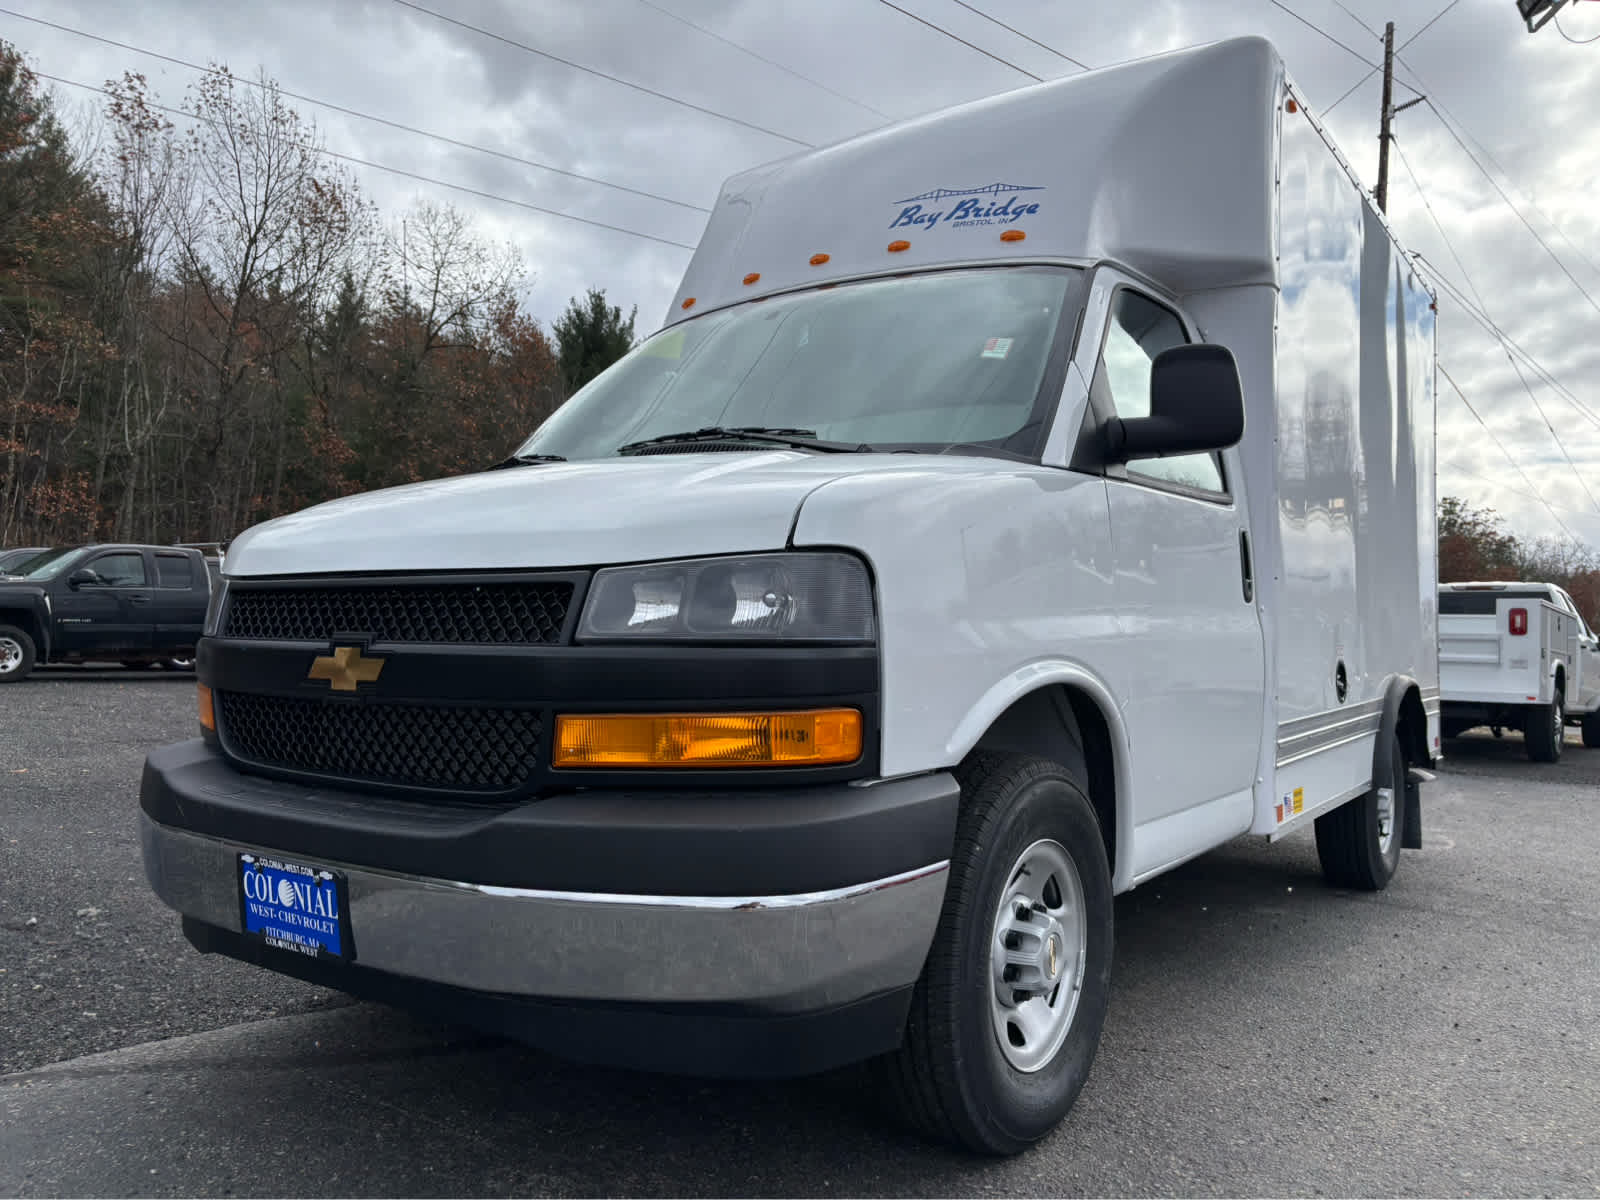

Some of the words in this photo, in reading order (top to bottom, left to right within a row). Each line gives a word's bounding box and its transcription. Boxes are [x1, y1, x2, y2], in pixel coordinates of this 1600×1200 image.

[888, 204, 943, 231] Bay
[943, 196, 1040, 222] Bridge
[243, 870, 339, 920] COLONIAL
[278, 910, 335, 935] CHEVROLET
[265, 937, 299, 952] COLONIAL
[300, 946, 319, 958] WEST
